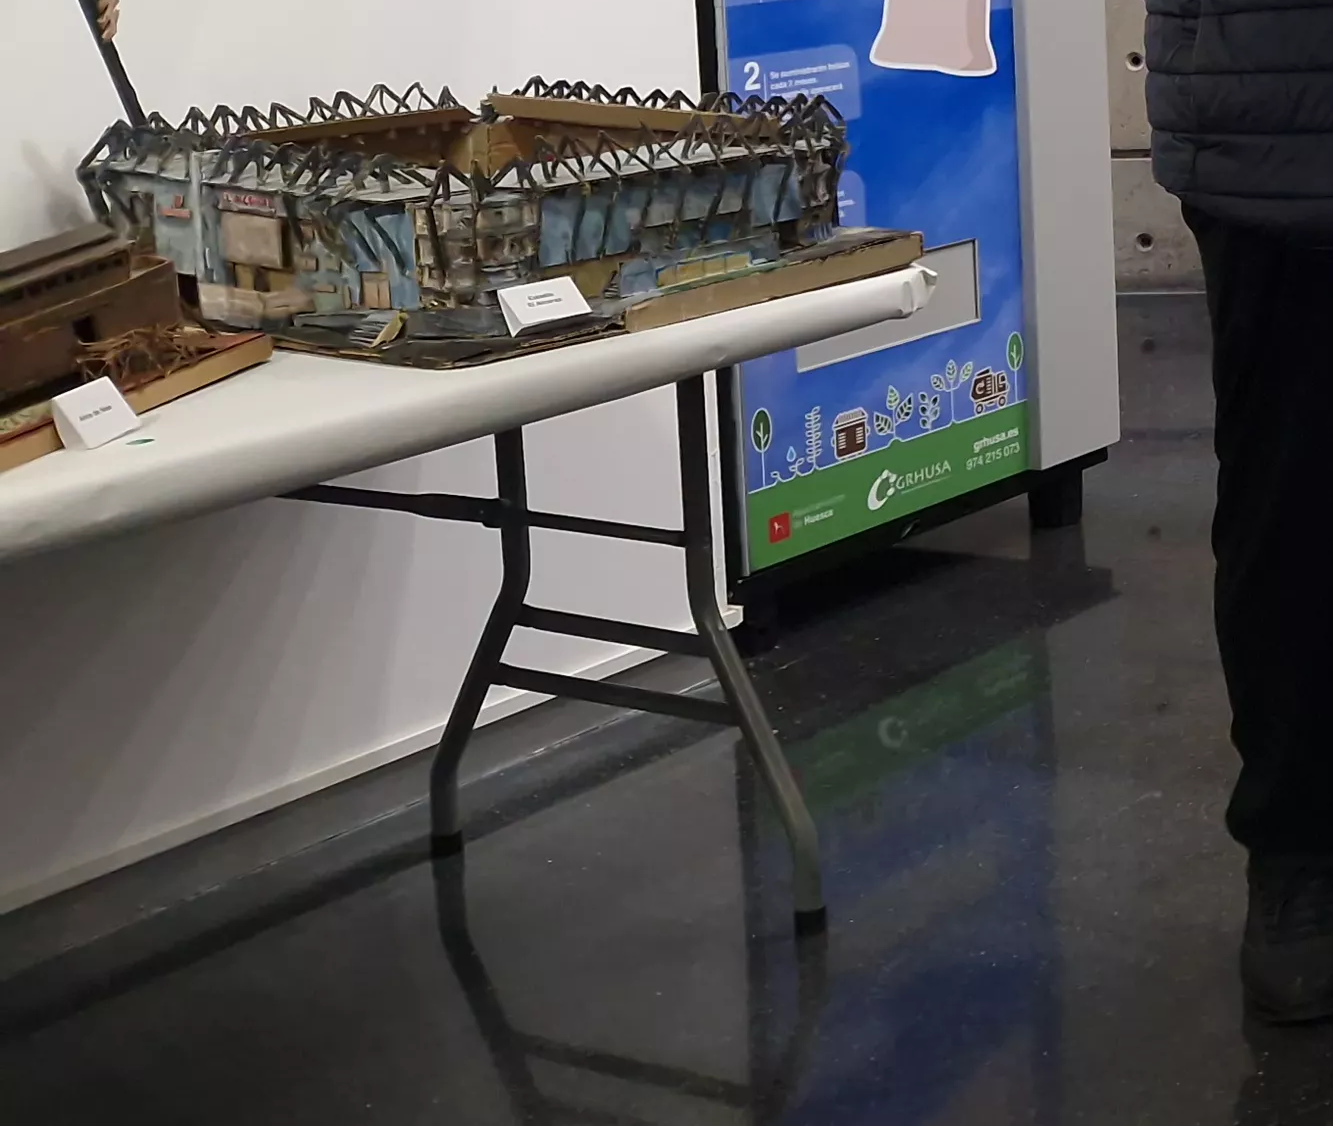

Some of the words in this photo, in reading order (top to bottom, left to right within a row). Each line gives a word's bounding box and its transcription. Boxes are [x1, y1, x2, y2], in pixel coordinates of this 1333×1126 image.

[744, 61, 761, 91] 2
[973, 427, 1019, 453] grhusa.es
[966, 455, 984, 470] 974
[985, 449, 1002, 464] 215
[1003, 442, 1021, 457] 073
[895, 460, 952, 489] GRHUSA
[804, 508, 834, 526] Huesca
